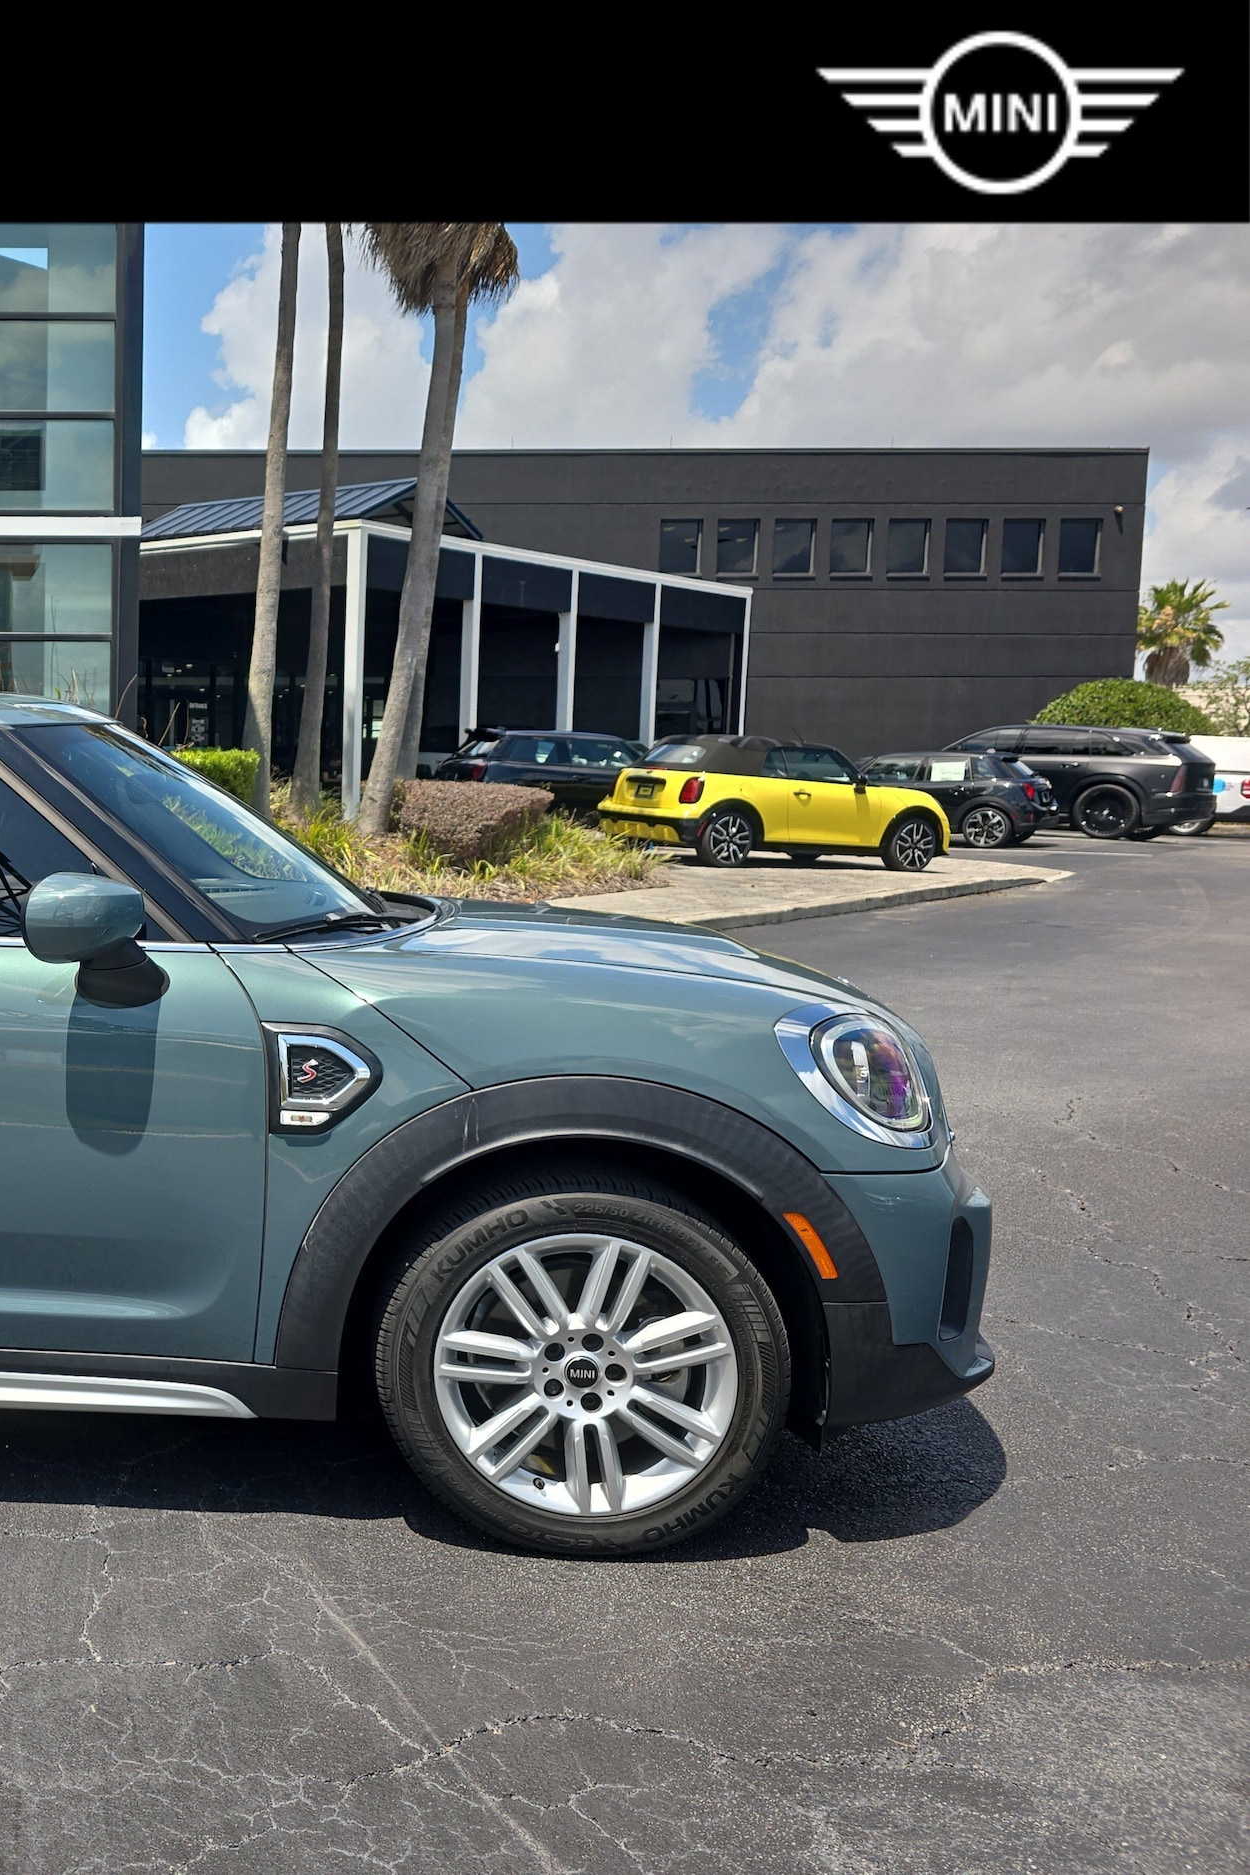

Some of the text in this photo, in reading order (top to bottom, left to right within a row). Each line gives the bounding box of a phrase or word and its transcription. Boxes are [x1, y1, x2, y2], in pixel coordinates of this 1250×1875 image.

[297, 1058, 319, 1083] S
[574, 1203, 630, 1218] 225/50
[431, 1209, 529, 1283] KUMHO
[570, 1368, 596, 1379] MINI
[642, 1473, 742, 1543] KUMHO
